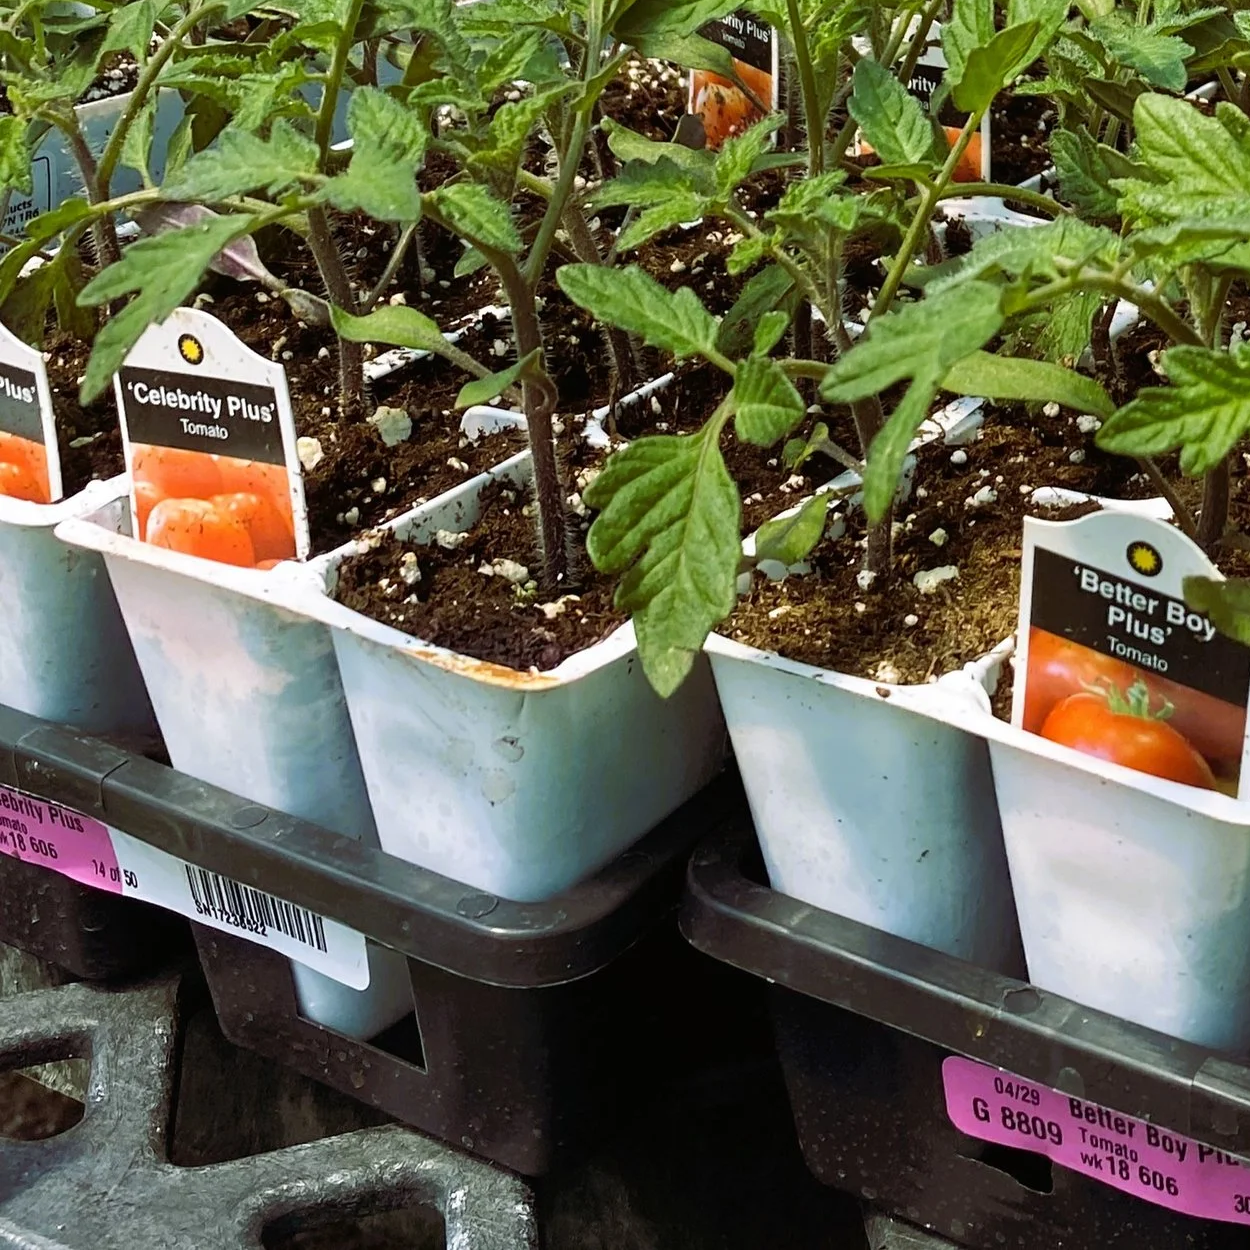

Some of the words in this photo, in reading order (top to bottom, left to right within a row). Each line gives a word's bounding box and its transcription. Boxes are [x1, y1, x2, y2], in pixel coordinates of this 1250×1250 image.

[8, 200, 33, 214] ucts
[127, 381, 221, 419] 'Celebrity
[226, 396, 275, 423] Plus'
[180, 418, 229, 440] Tomato
[1073, 565, 1159, 615] 'Better
[1166, 600, 1216, 642] Boy
[1108, 605, 1172, 645] Plus'
[1106, 635, 1168, 672] Tomato
[0, 791, 43, 824] ebrity
[48, 805, 84, 833] Plus
[0, 816, 28, 835] omato
[29, 836, 58, 859] 606
[92, 859, 106, 878] 14
[109, 866, 121, 882] of
[123, 869, 138, 888] 50
[994, 1077, 1040, 1106] 04/29
[972, 1097, 990, 1123] G
[1001, 1106, 1062, 1146] 8809
[1069, 1097, 1136, 1138] Better
[1146, 1124, 1188, 1162] Boy
[1078, 1127, 1138, 1163] Tomato
[1138, 1165, 1179, 1196] 606
